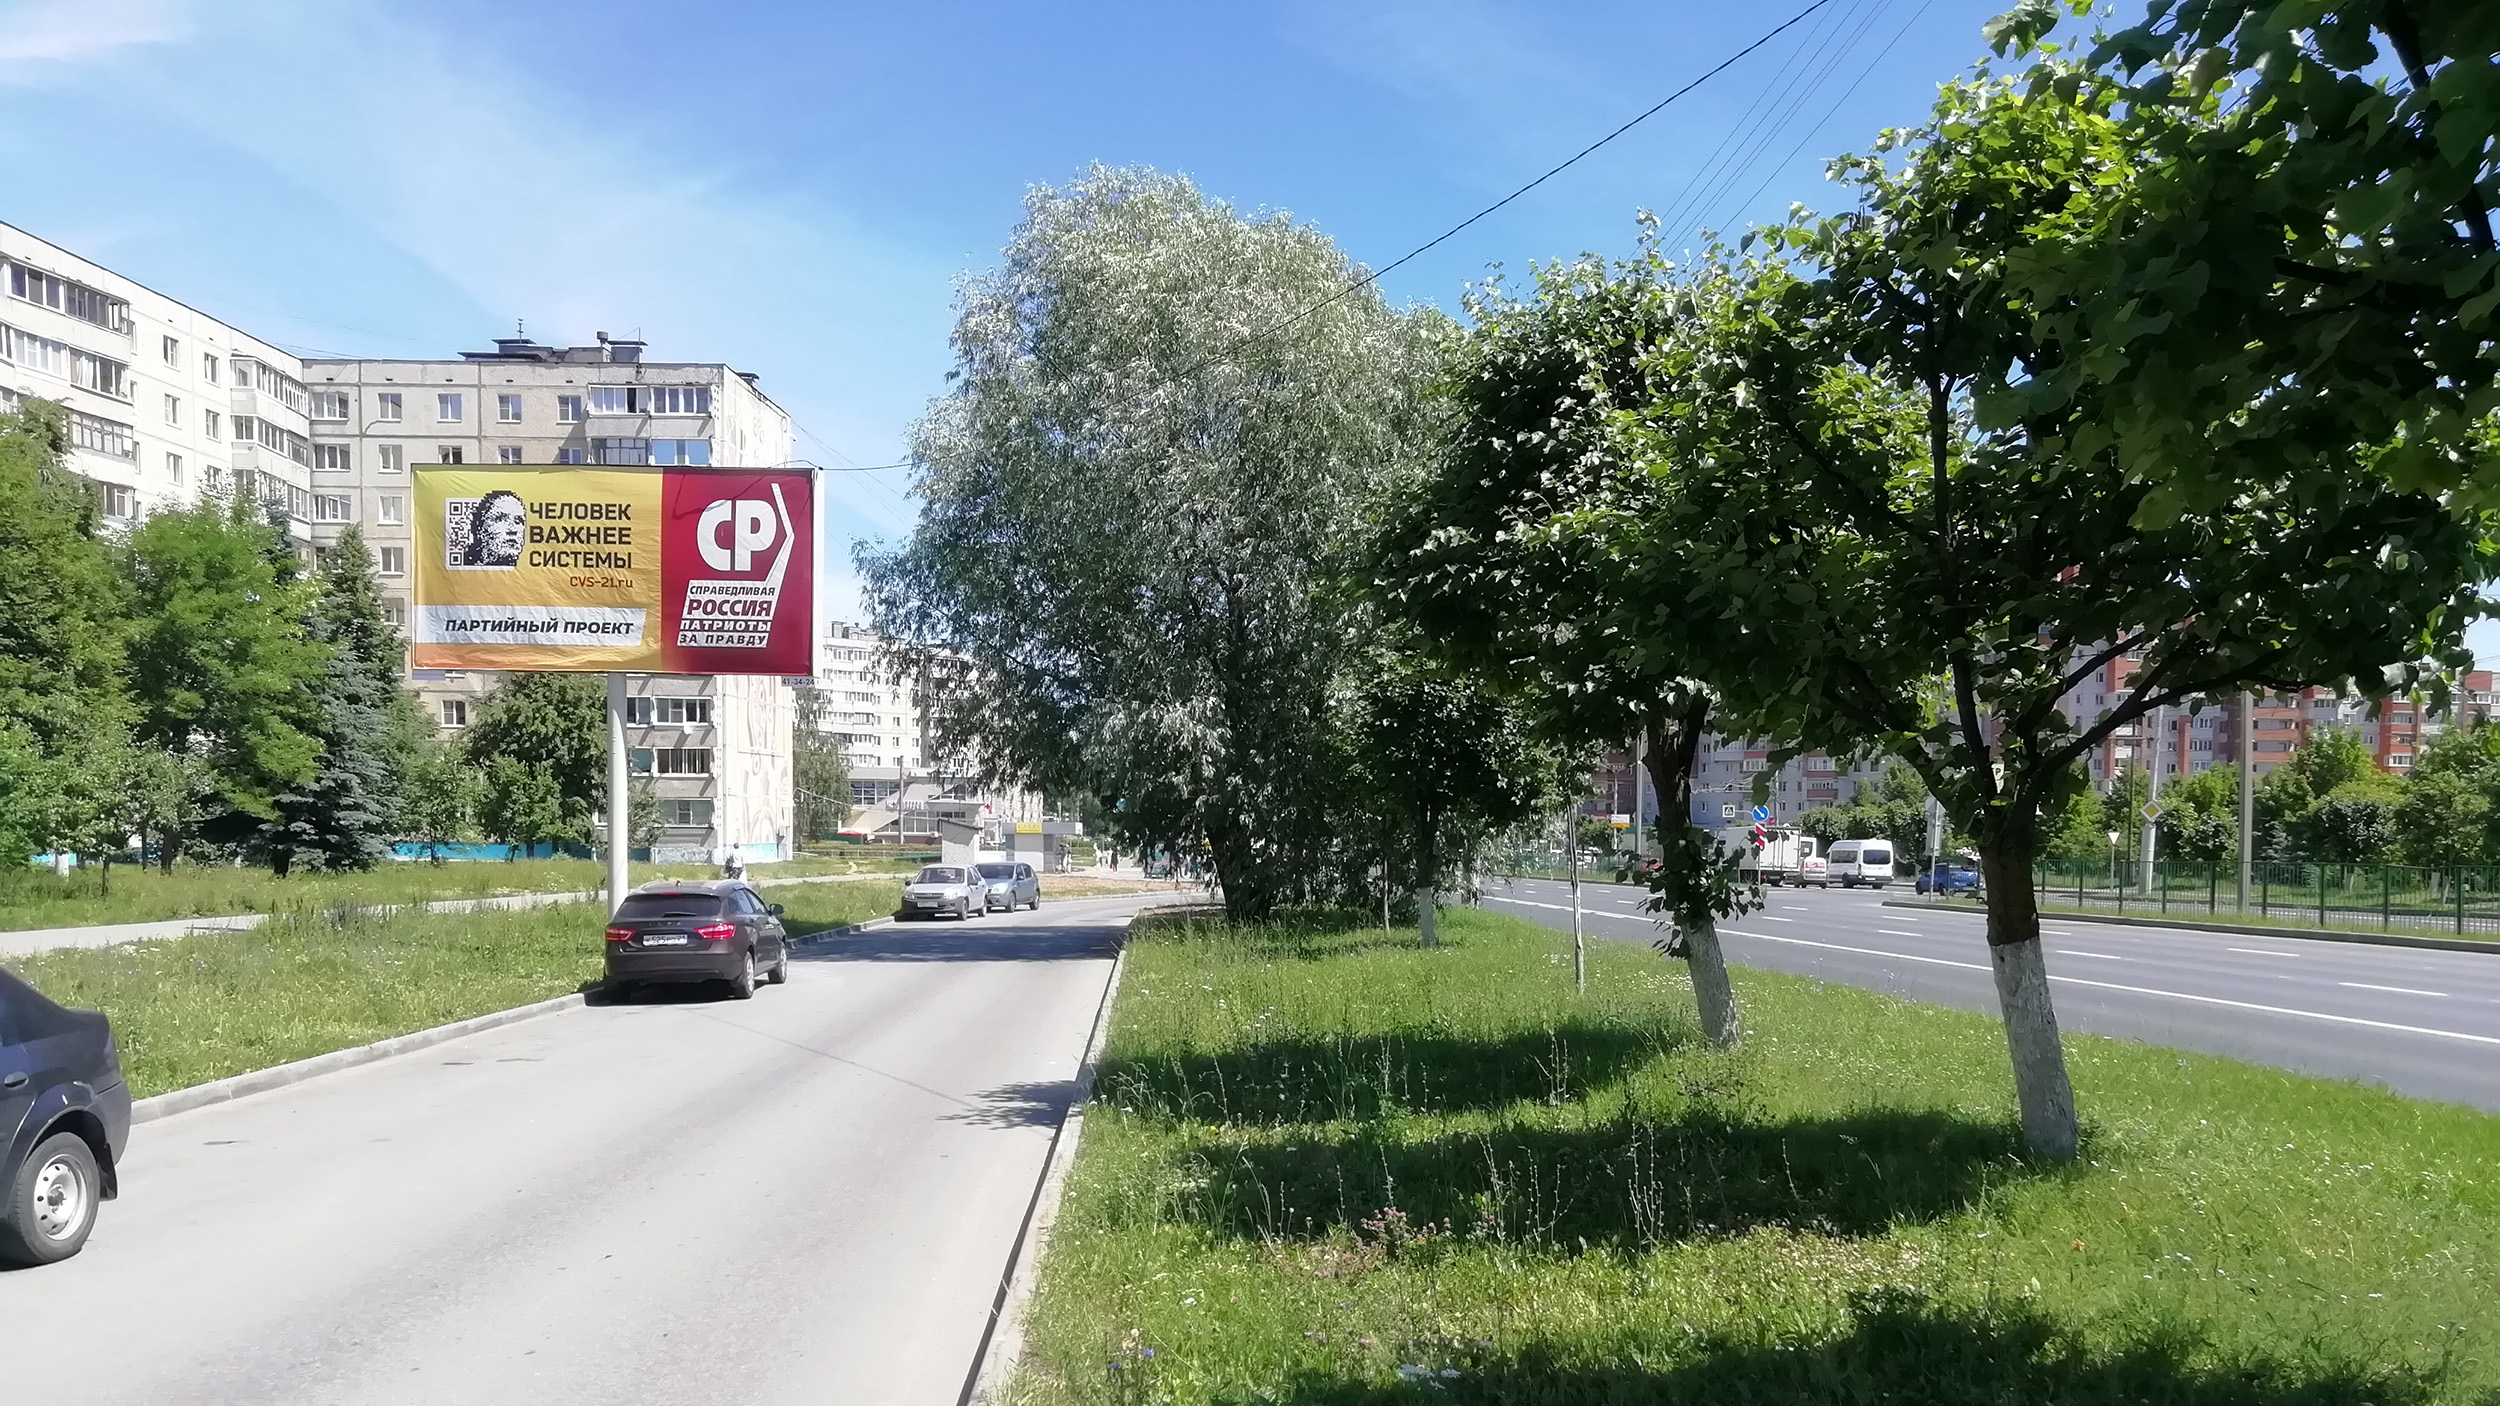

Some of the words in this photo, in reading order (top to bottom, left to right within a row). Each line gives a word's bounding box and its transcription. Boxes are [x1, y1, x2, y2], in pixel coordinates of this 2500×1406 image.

[529, 502, 632, 521] ЧЕЛОВЕК
[529, 525, 632, 545] ВАЖНЕЕ
[697, 499, 777, 571] СР
[529, 550, 632, 569] СИСТЕМЫ
[569, 576, 634, 588] CVS-21.ru
[689, 585, 776, 597] СПРАВЕДЛИВАЯ
[686, 598, 773, 617] РОССИЯ
[444, 617, 559, 633] ПАРТИЙНЫЙ
[562, 621, 634, 635] ПРОЕКТ
[680, 619, 771, 631] ПАТРИОТЫ
[679, 633, 698, 644] ЗА
[705, 634, 767, 646] ПРАВДУ
[782, 677, 815, 686] 41-34-24
